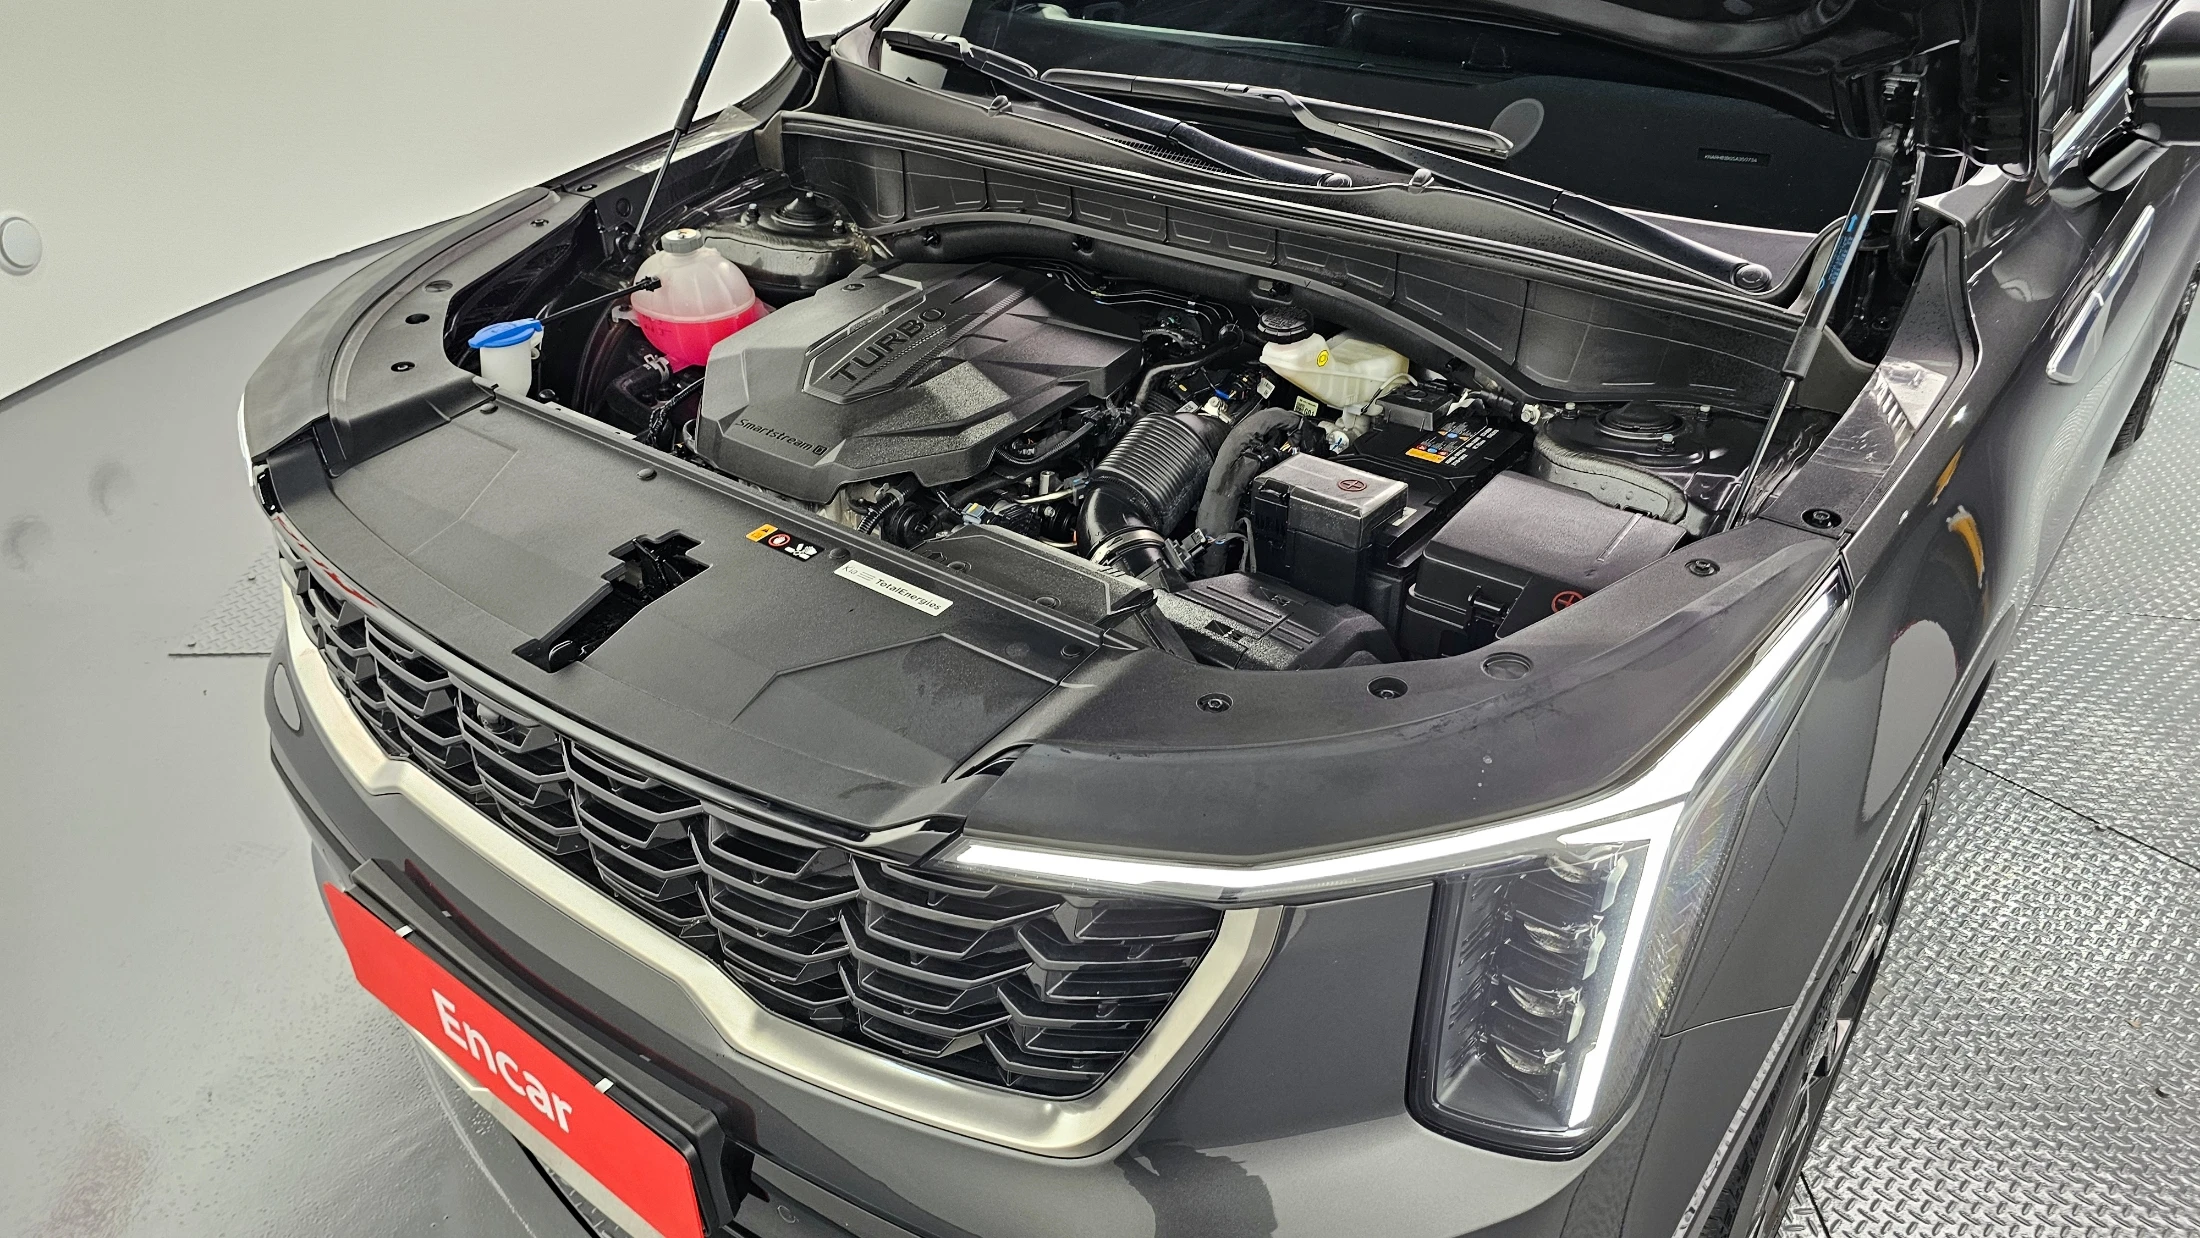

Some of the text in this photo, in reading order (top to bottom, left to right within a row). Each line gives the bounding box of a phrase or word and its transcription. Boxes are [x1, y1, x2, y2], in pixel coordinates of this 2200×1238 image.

[829, 307, 946, 381] TURBO
[735, 418, 813, 451] Smartstream
[842, 564, 942, 610] Kia TotalEnergies
[431, 988, 573, 1134] Encar
